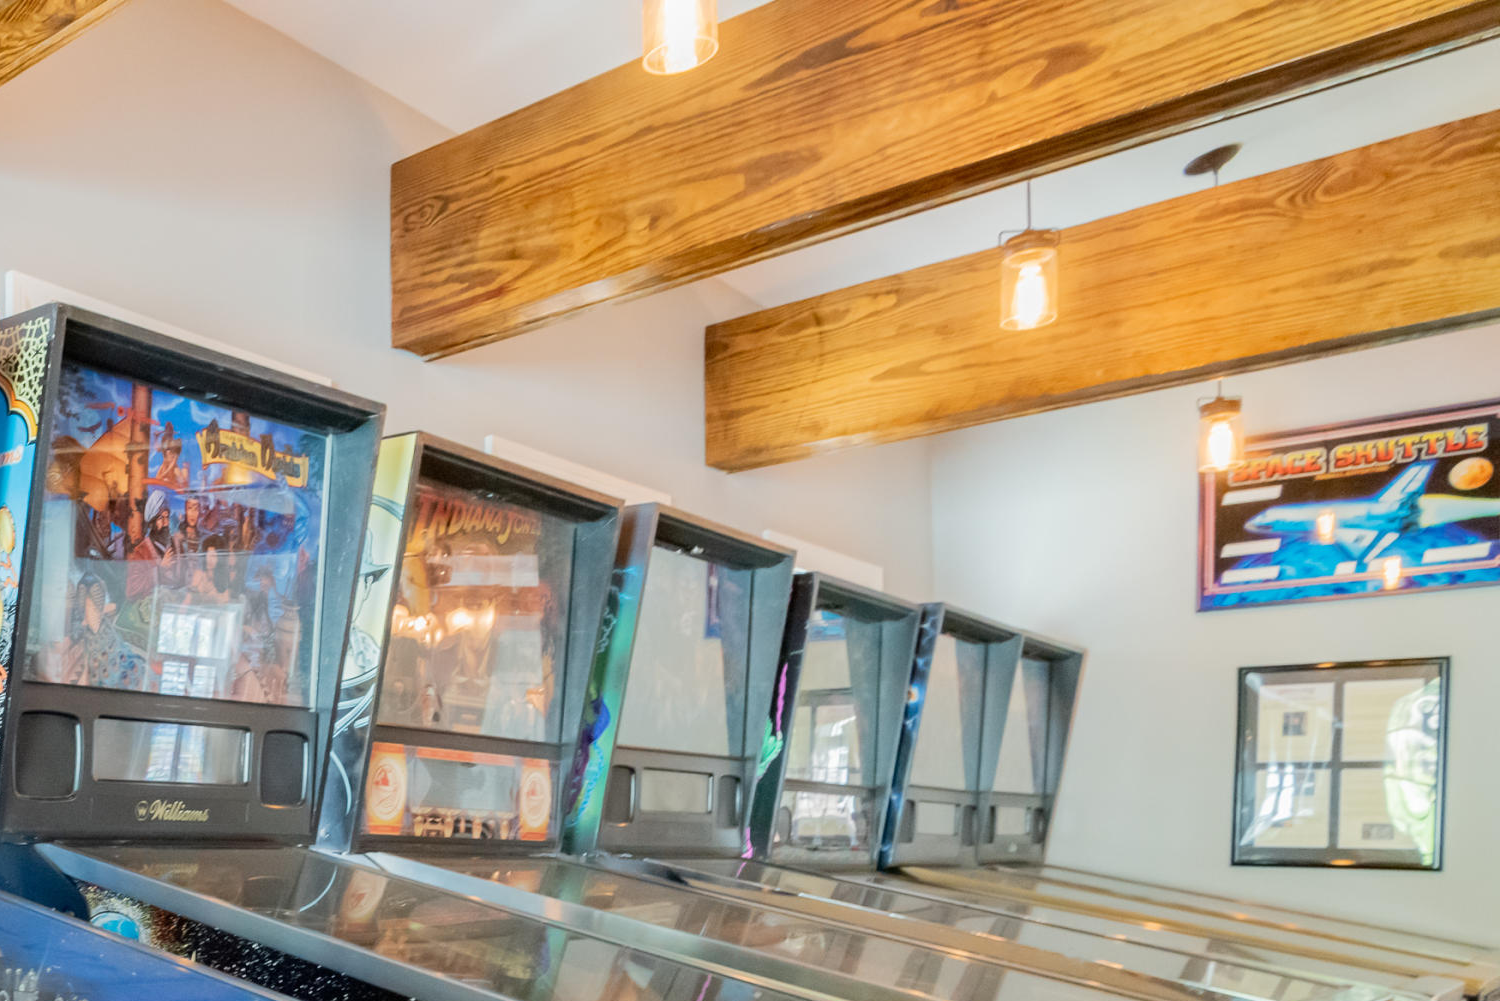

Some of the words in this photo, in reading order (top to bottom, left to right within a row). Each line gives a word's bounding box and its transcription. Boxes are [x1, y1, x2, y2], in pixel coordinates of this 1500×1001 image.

[1228, 447, 1327, 486] SPACE
[1329, 423, 1489, 473] SHUTTLE
[149, 799, 211, 822] Williams
